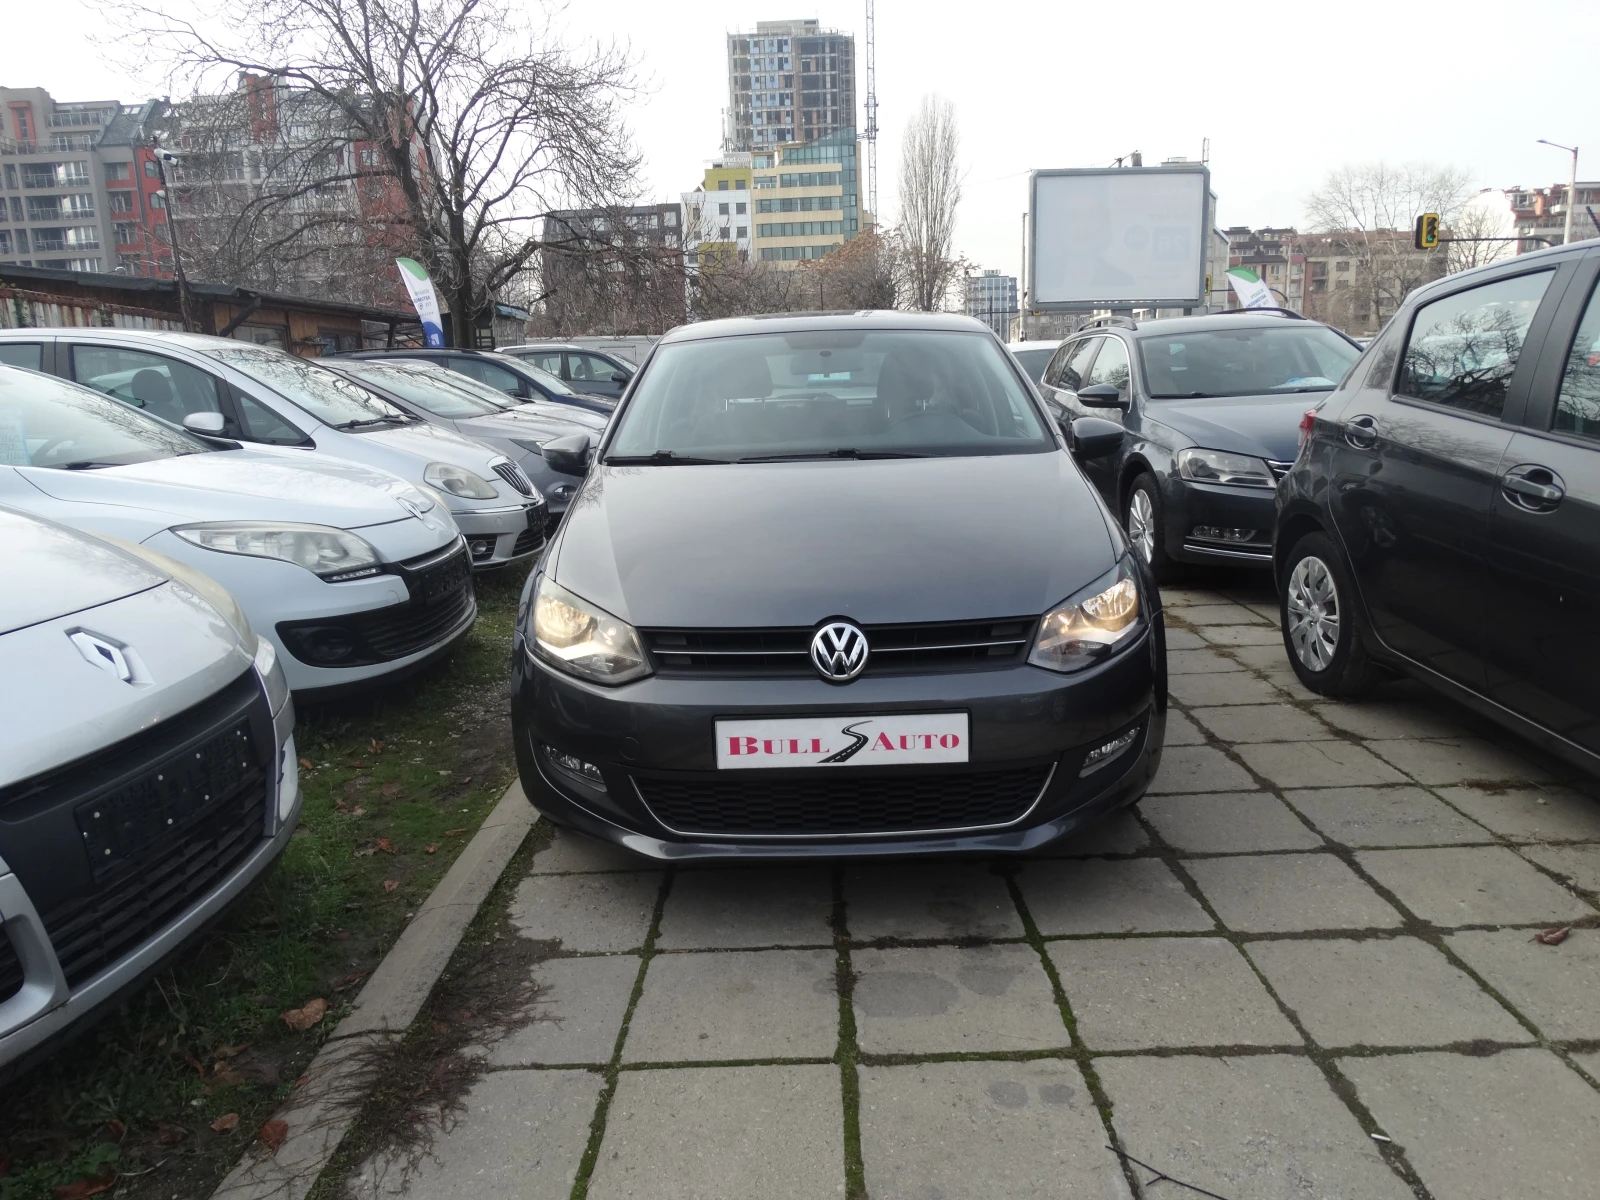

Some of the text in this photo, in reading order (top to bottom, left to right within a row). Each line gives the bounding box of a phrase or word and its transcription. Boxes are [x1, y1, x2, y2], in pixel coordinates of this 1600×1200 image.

[811, 623, 868, 680] VW
[726, 731, 960, 756] BULL AUTO
